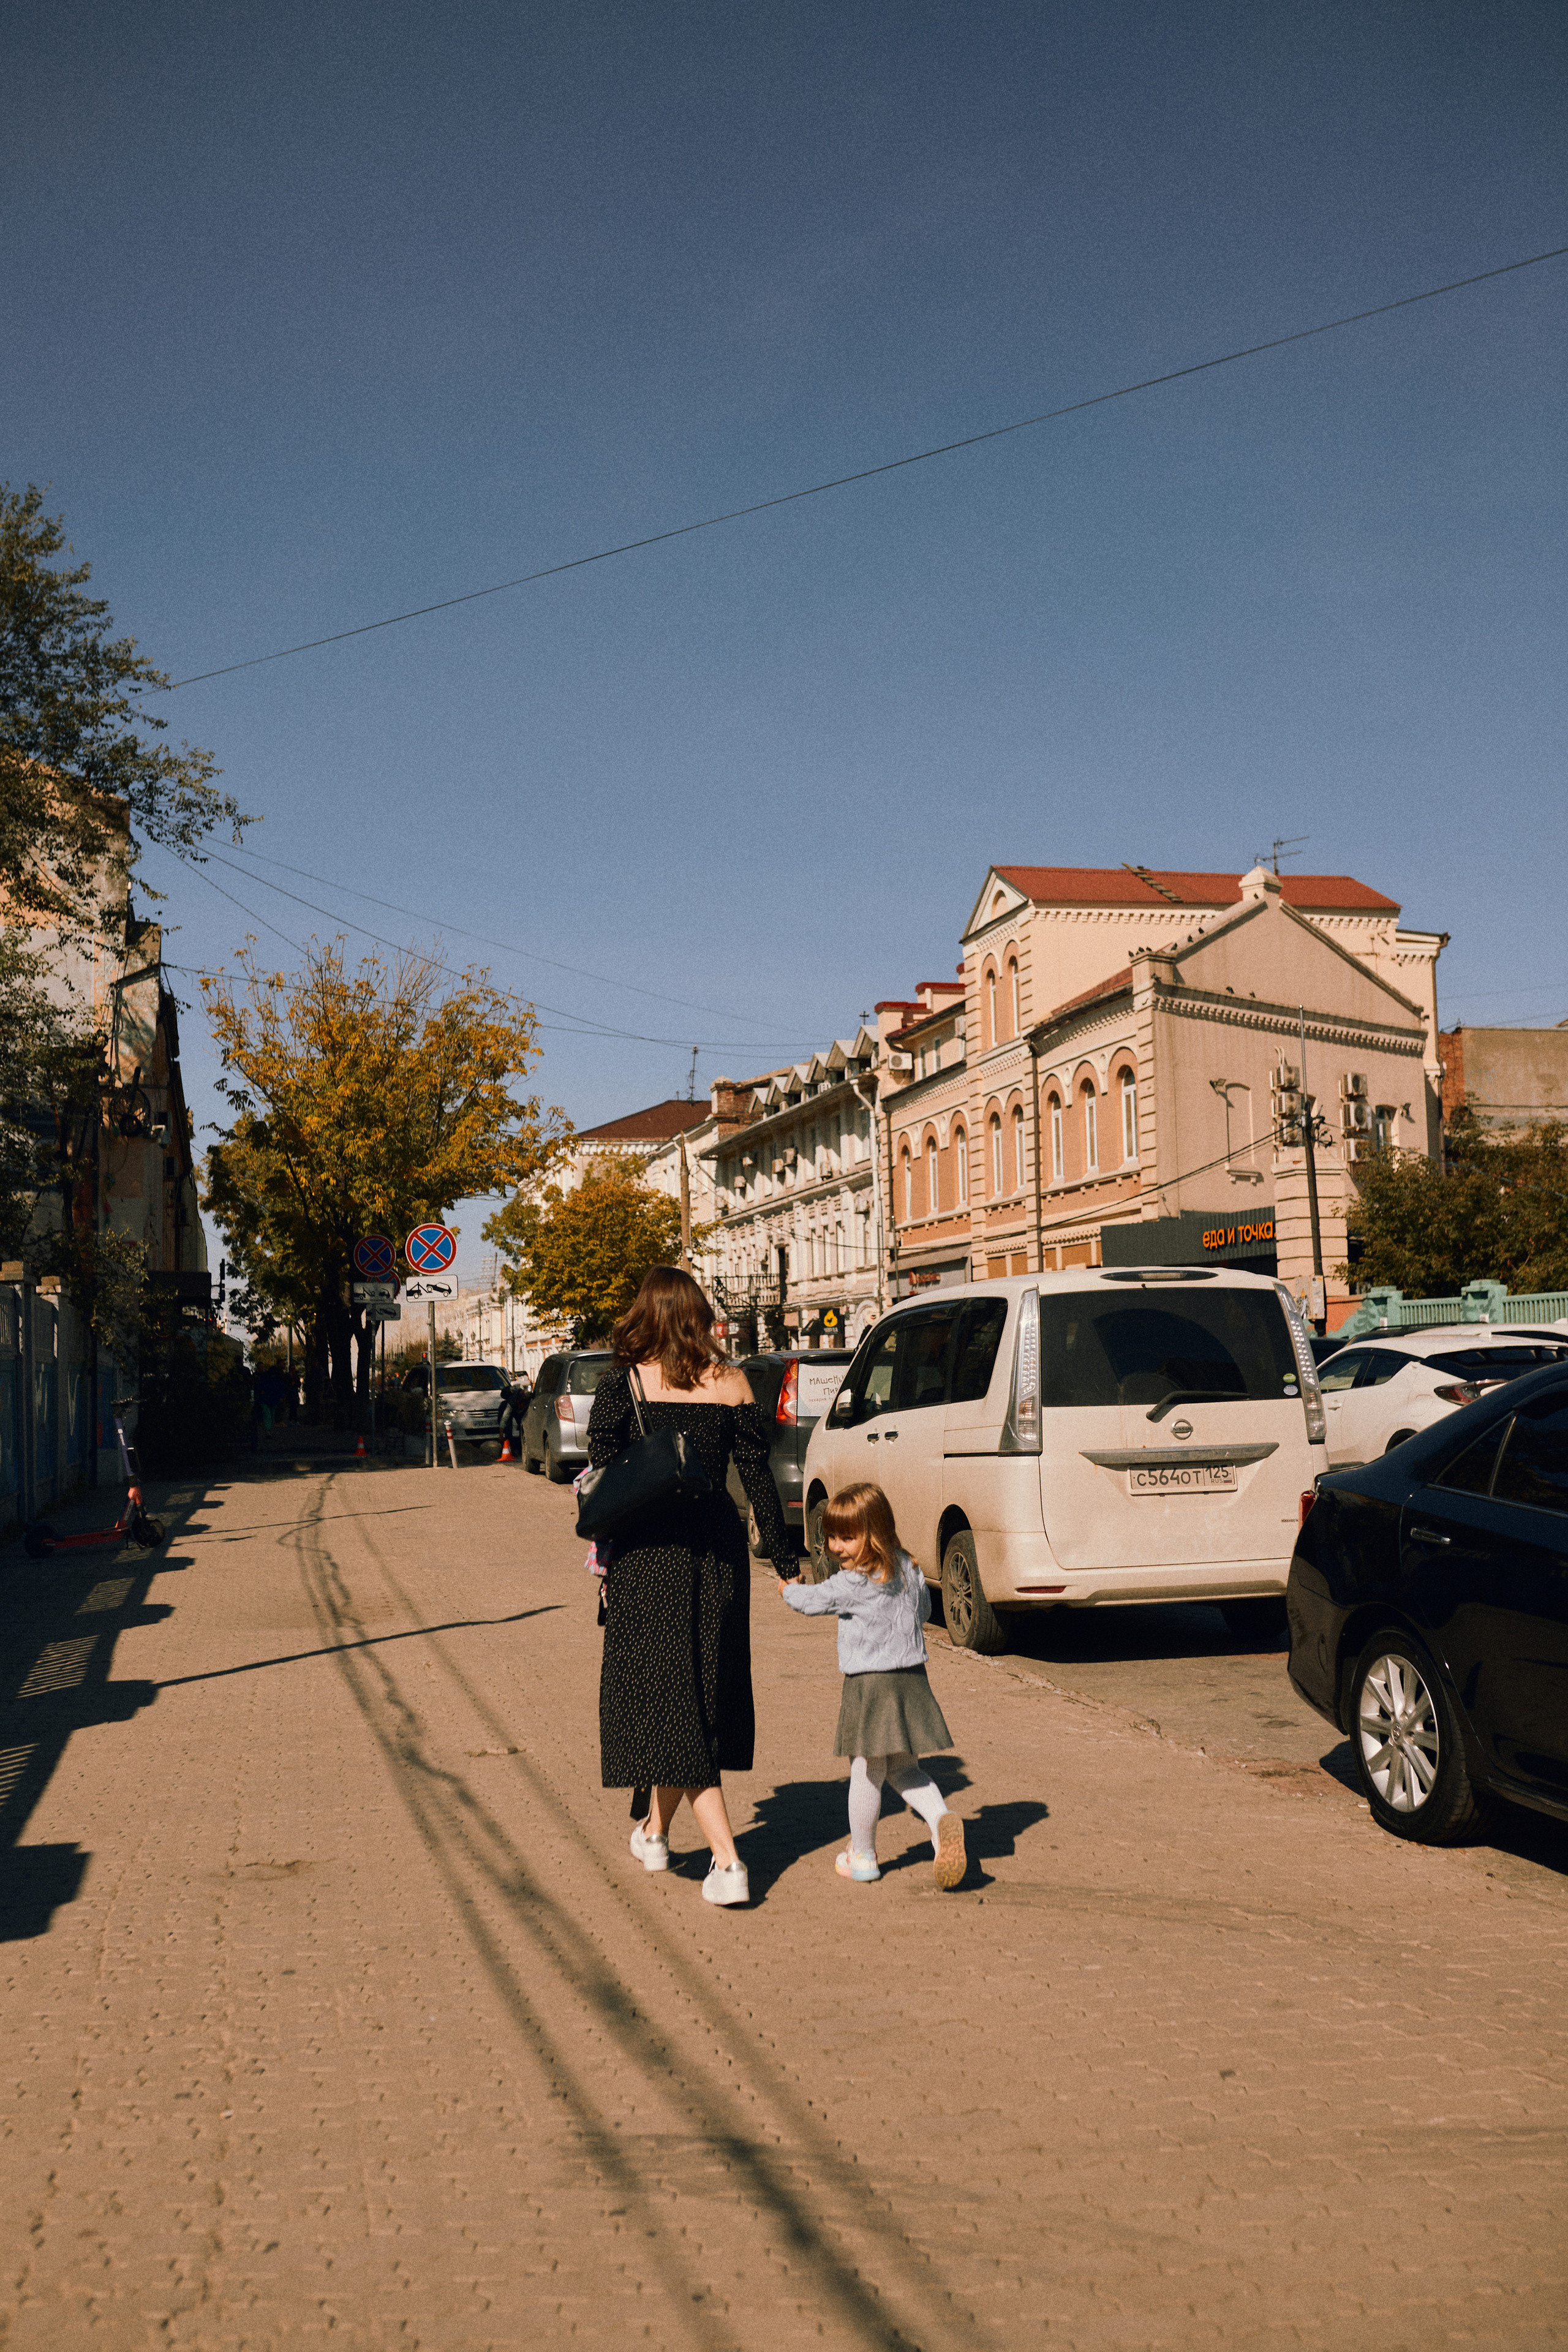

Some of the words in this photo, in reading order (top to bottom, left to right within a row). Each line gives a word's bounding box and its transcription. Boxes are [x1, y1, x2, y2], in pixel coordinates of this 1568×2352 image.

[1202, 1229, 1224, 1250] еда
[1227, 1227, 1235, 1244] и
[1237, 1221, 1276, 1242] точка.
[1137, 1468, 1201, 1486] С564ОТ
[1205, 1464, 1229, 1479] 125
